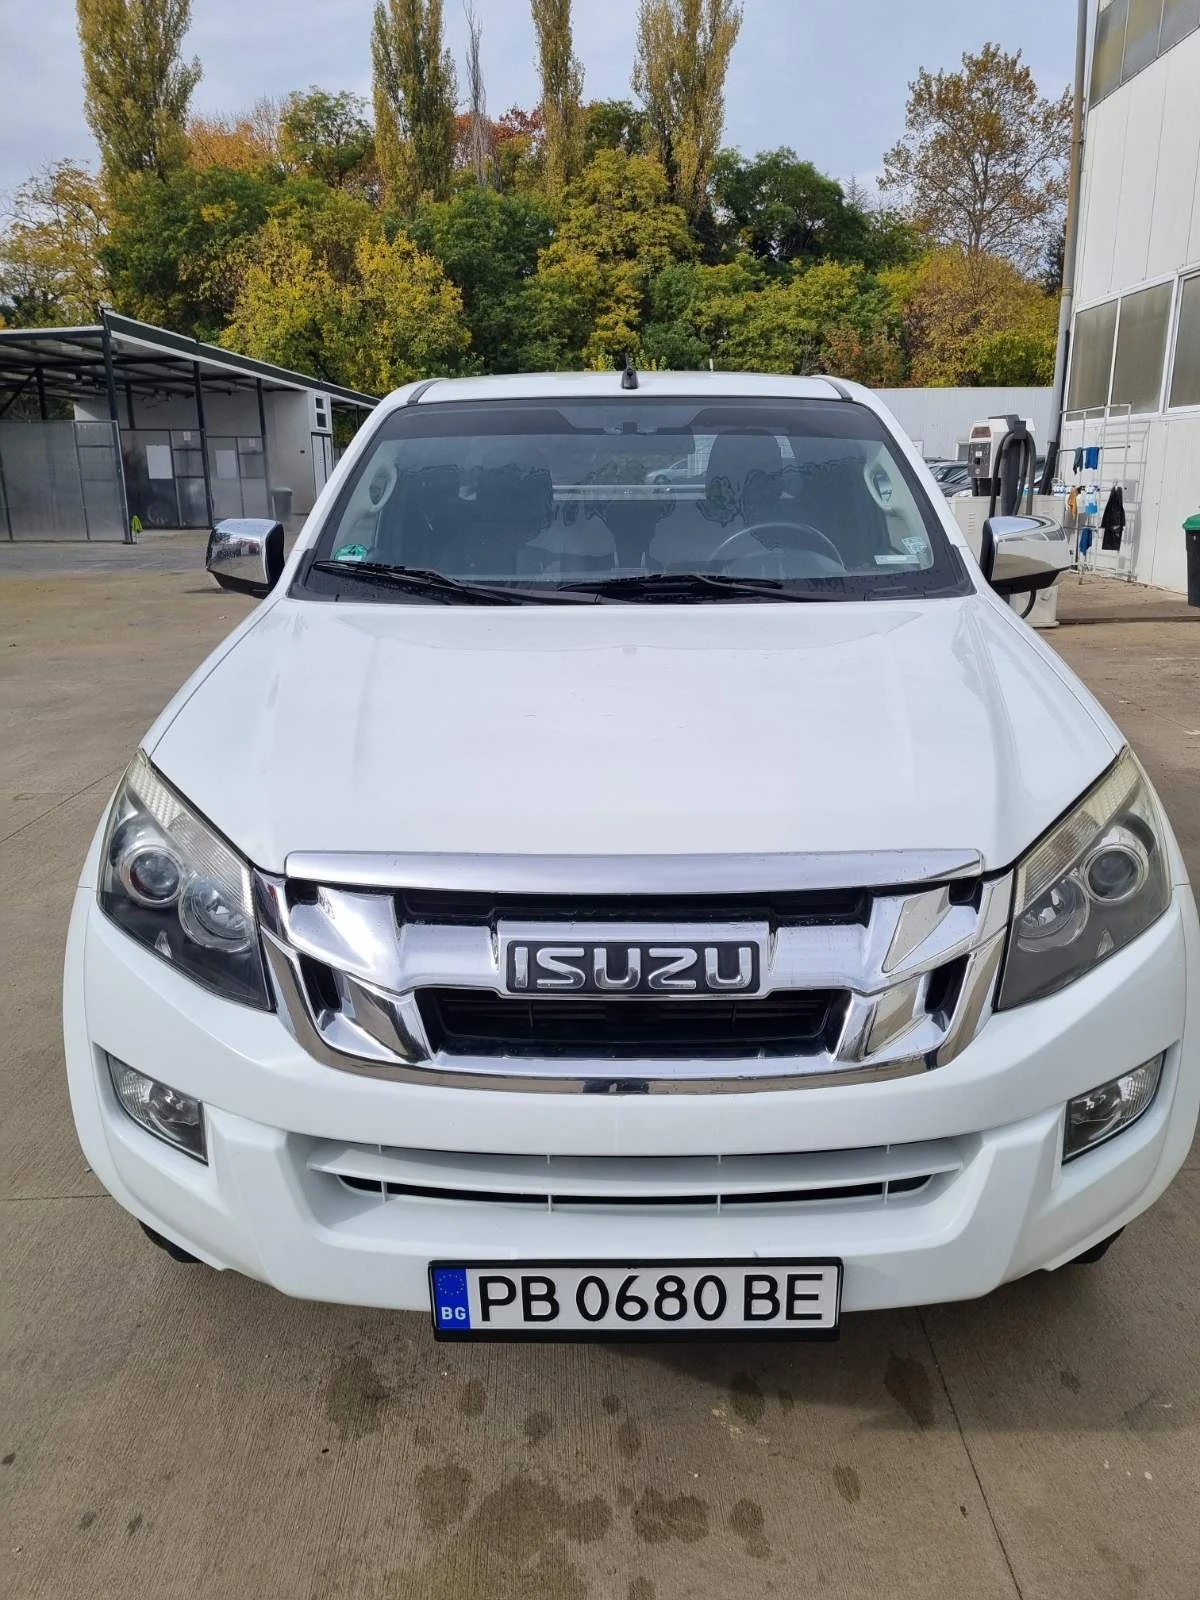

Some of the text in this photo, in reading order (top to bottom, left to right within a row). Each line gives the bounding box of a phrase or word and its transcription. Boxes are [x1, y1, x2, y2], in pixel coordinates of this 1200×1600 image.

[515, 947, 752, 990] ISUZU
[441, 1306, 467, 1321] BG
[478, 1273, 823, 1322] PB 0680 BE
